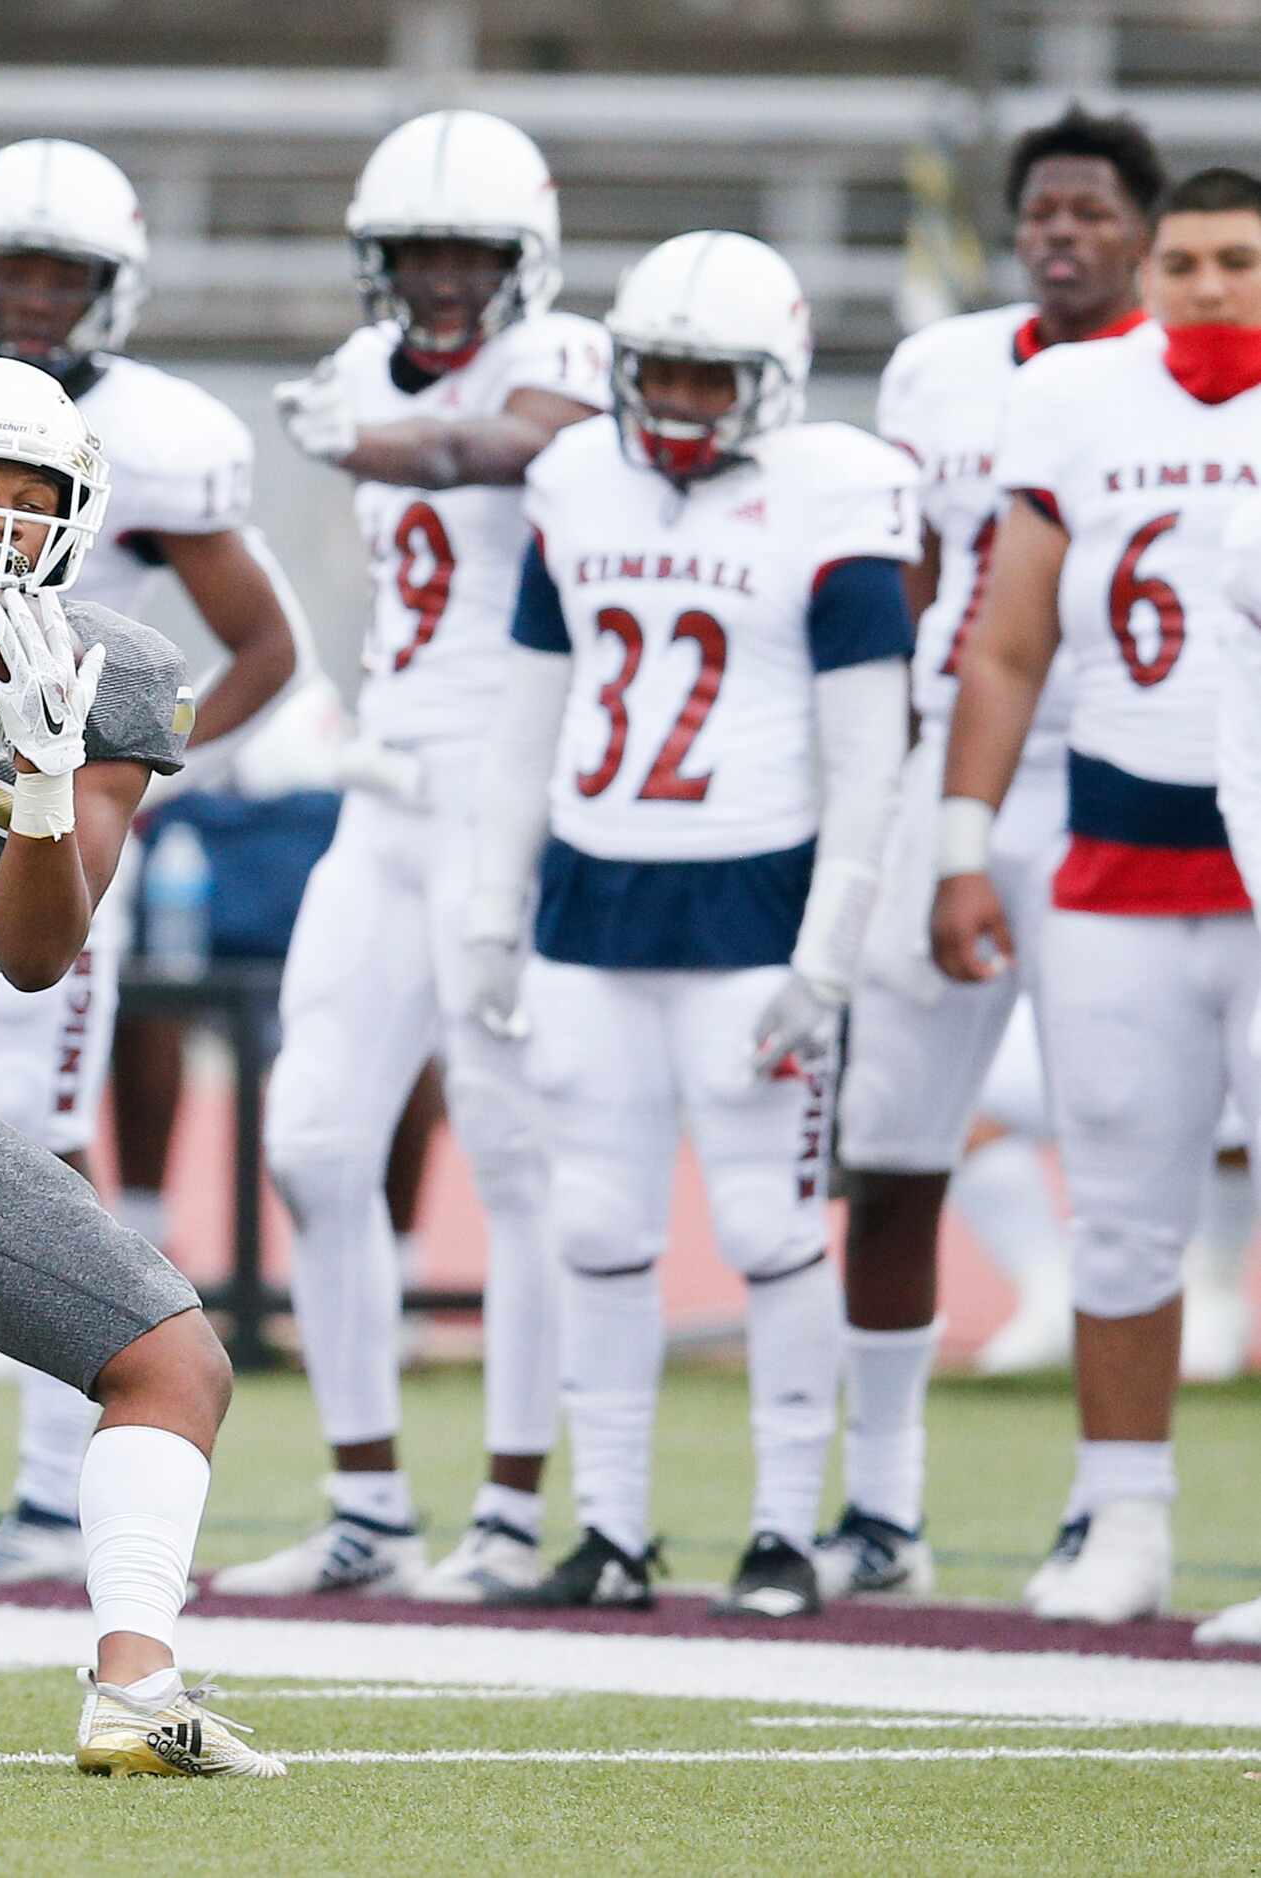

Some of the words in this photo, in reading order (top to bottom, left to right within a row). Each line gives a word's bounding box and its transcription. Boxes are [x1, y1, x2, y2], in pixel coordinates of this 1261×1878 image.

[577, 556, 754, 595] KIMBALL
[1107, 510, 1186, 687] 6
[577, 606, 728, 802] 32
